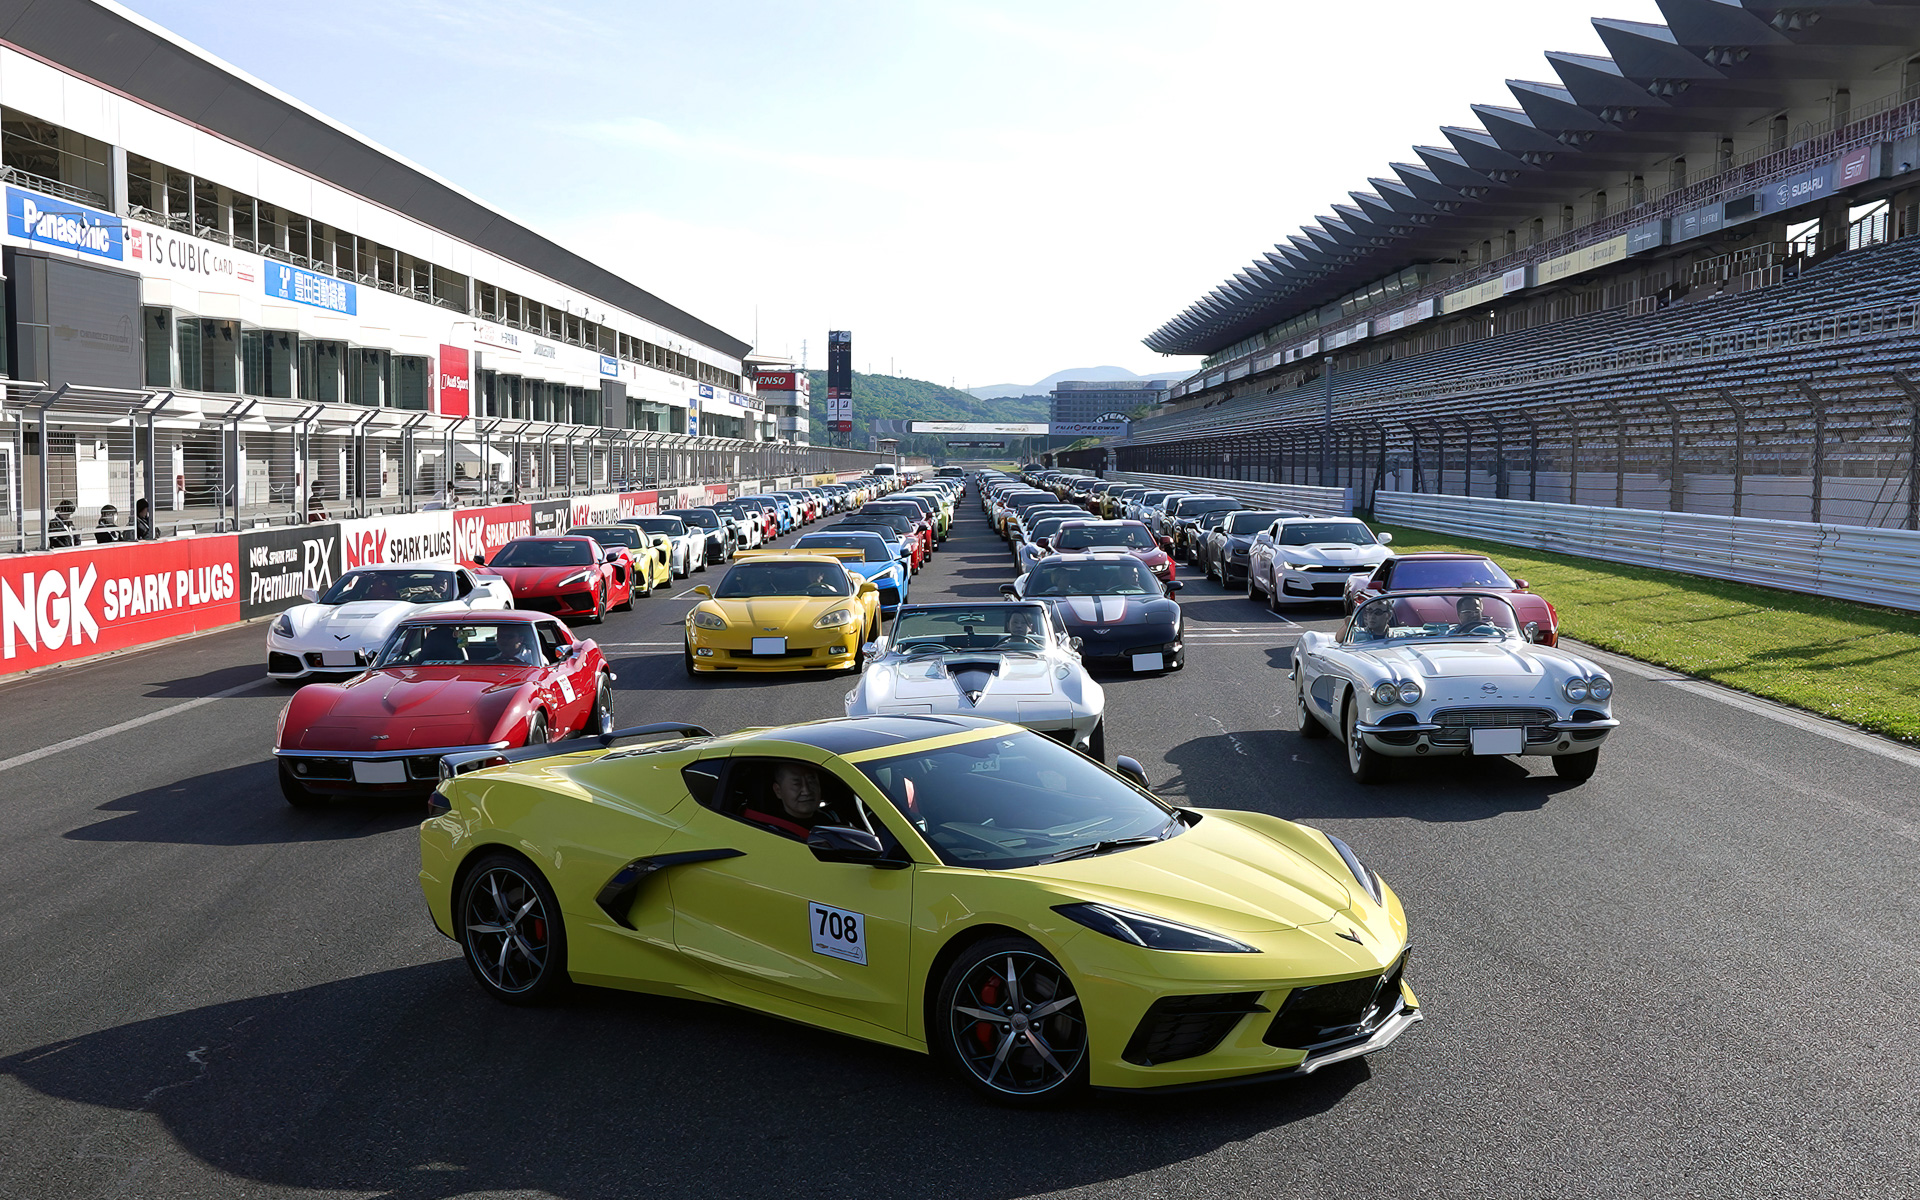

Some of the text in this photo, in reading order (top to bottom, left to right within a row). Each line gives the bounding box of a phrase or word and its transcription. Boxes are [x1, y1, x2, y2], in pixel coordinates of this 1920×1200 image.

[1792, 176, 1823, 197] SUBARU
[23, 198, 110, 253] Panasonic
[146, 232, 163, 264] TS
[168, 239, 210, 275] CUBIC
[213, 256, 233, 275] CARD
[455, 515, 486, 563] NGK
[486, 523, 509, 548] SPARK
[509, 519, 531, 542] PLUGS
[555, 507, 569, 536] RX
[249, 545, 298, 568] NGK SPARK PLUG
[302, 536, 335, 592] RX
[345, 527, 451, 571] NGK SPARK PLUGS
[250, 566, 303, 606] Premium
[1, 561, 235, 660] NGK SPARK PLUGS
[815, 908, 858, 943] 708
